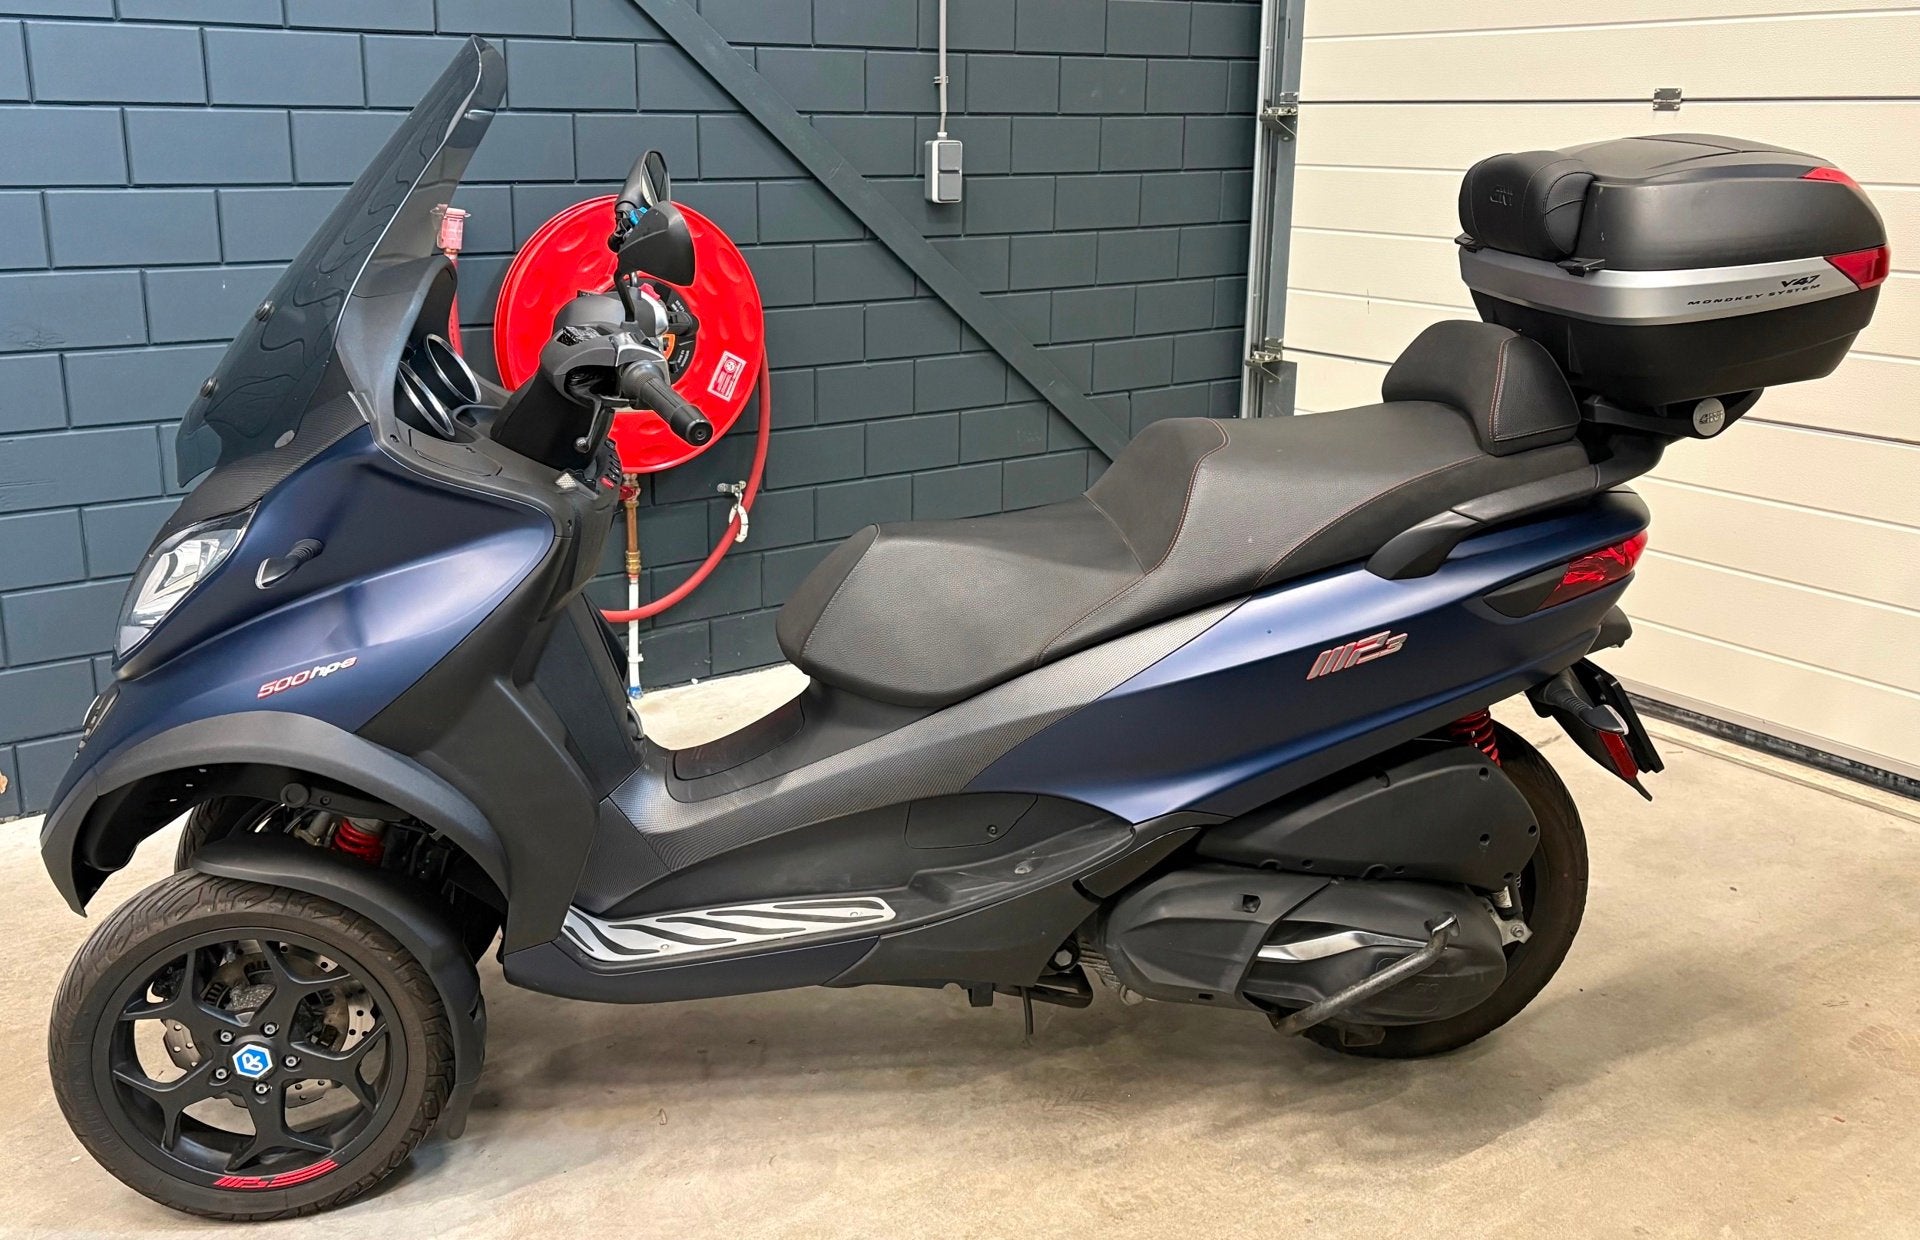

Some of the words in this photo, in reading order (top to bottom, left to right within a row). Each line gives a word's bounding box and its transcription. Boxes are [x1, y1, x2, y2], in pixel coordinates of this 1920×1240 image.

[1781, 274, 1821, 288] V47
[1687, 293, 1764, 306] MONOKEY
[1768, 283, 1821, 297] SYSTEM
[1306, 630, 1408, 680] MP3
